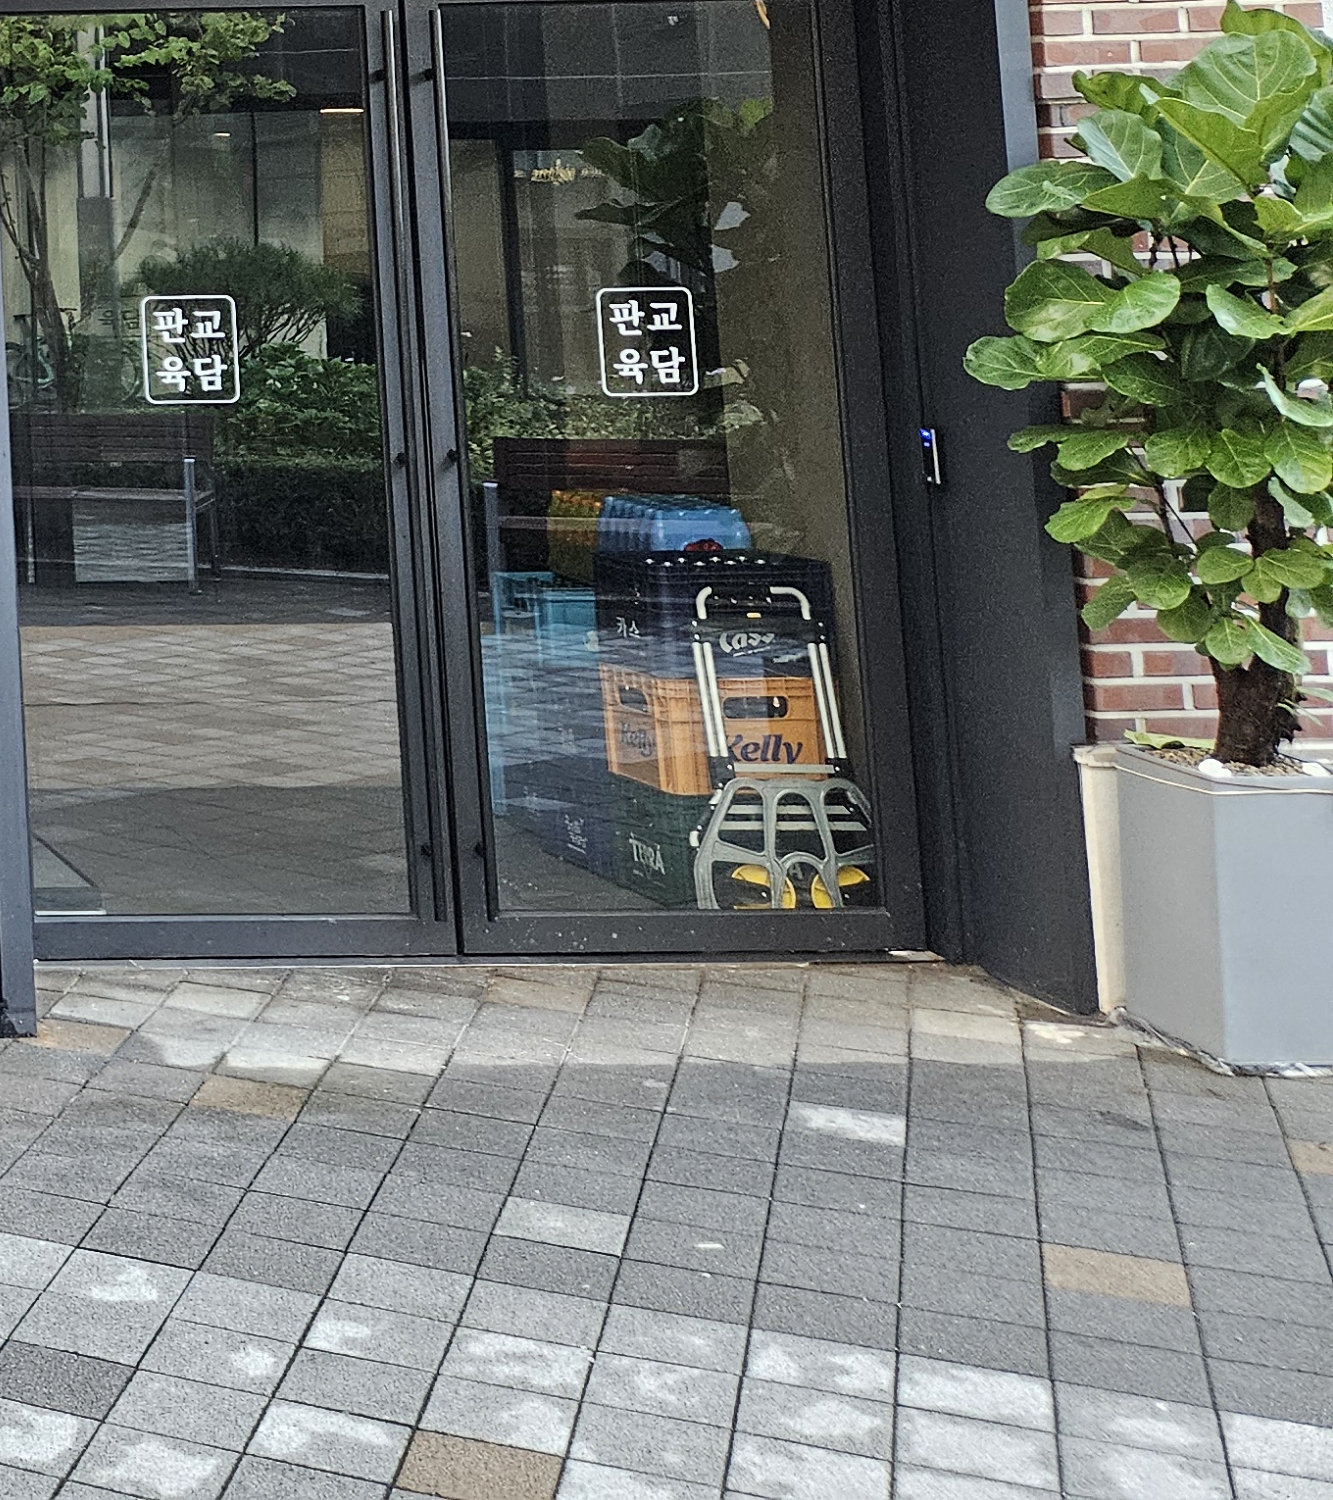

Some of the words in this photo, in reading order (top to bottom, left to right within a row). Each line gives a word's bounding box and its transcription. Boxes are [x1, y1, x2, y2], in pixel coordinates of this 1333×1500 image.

[153, 306, 225, 343] 판교
[609, 300, 683, 337] 판교
[157, 354, 228, 392] 육담
[612, 346, 686, 385] 육담
